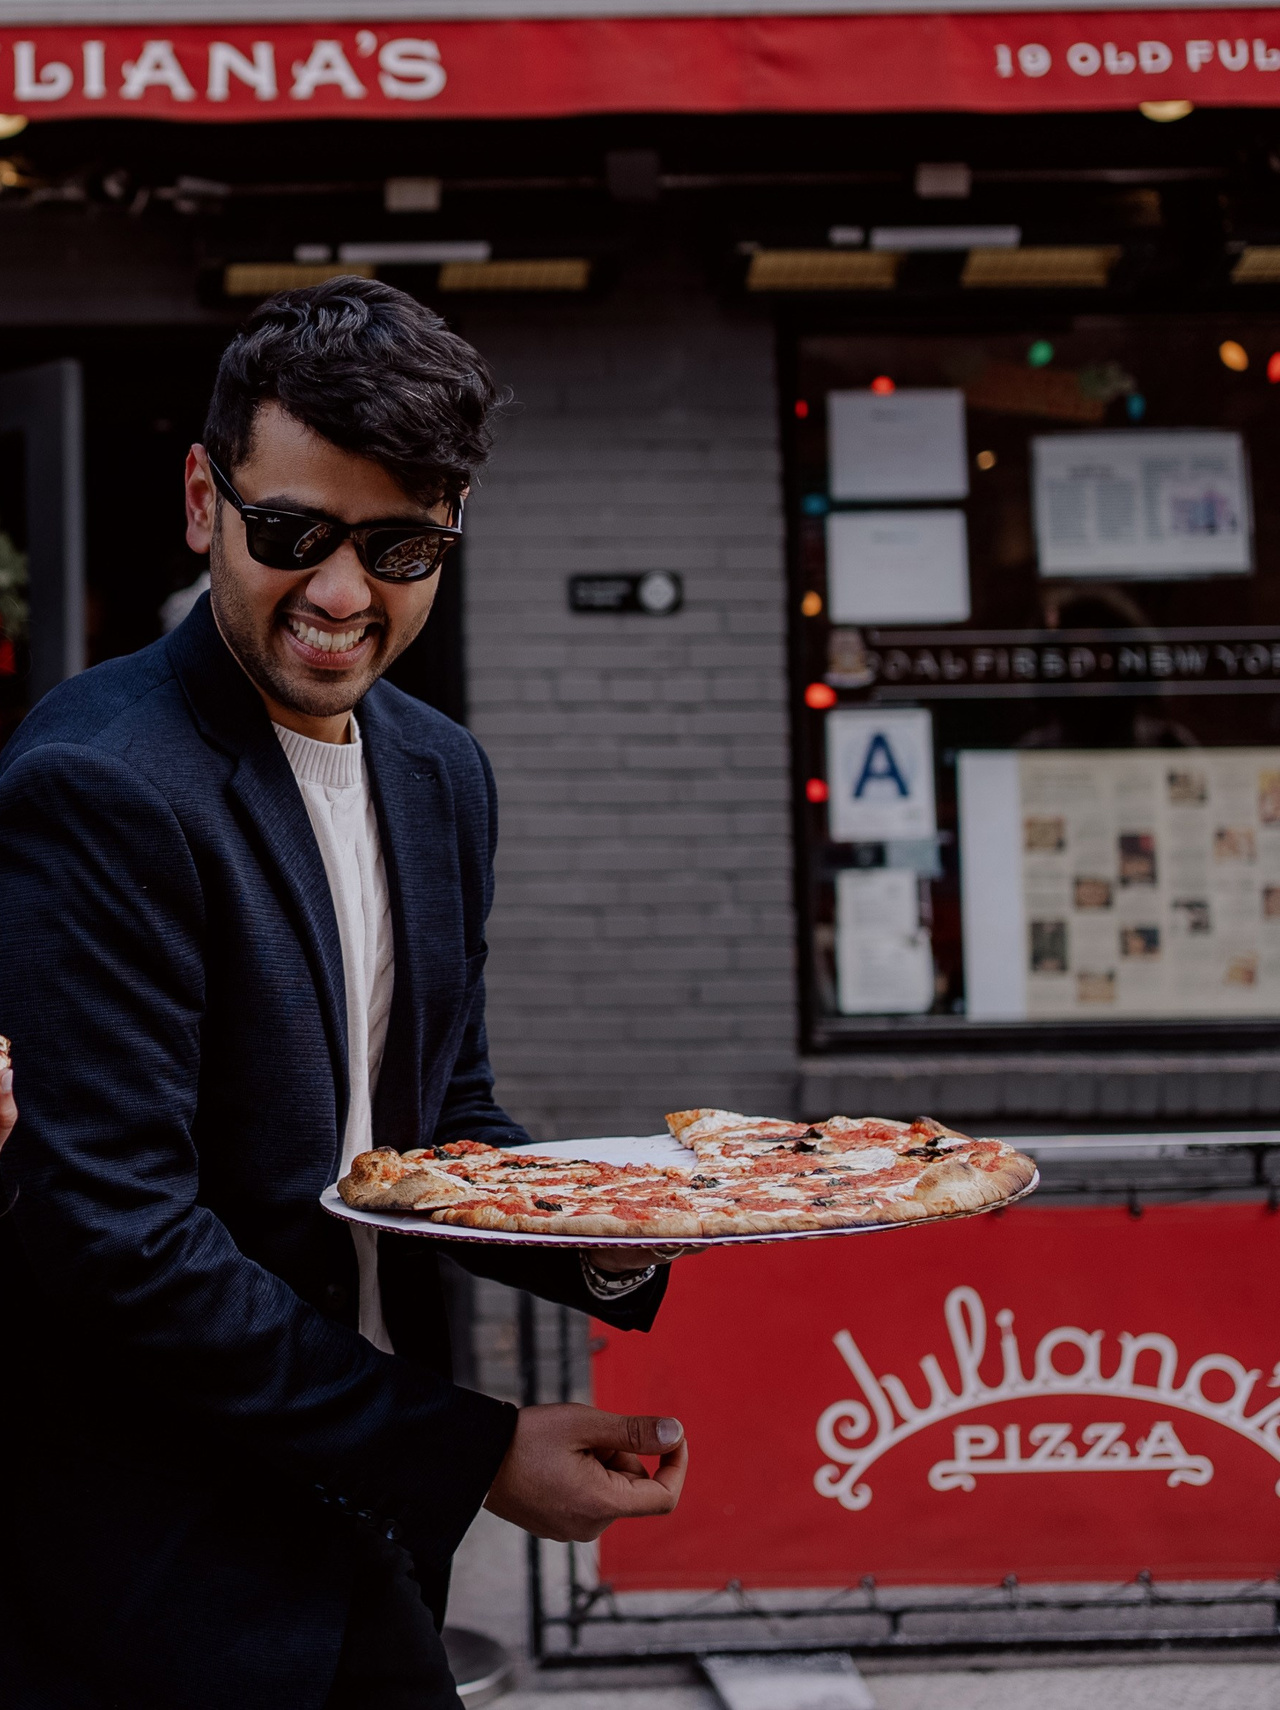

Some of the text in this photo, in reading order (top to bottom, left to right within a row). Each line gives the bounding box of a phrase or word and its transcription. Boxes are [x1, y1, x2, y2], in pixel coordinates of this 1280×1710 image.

[994, 43, 1052, 78] 19
[1066, 40, 1173, 77] OLD
[852, 733, 910, 799] A
[952, 1421, 1190, 1468] PIZZA
